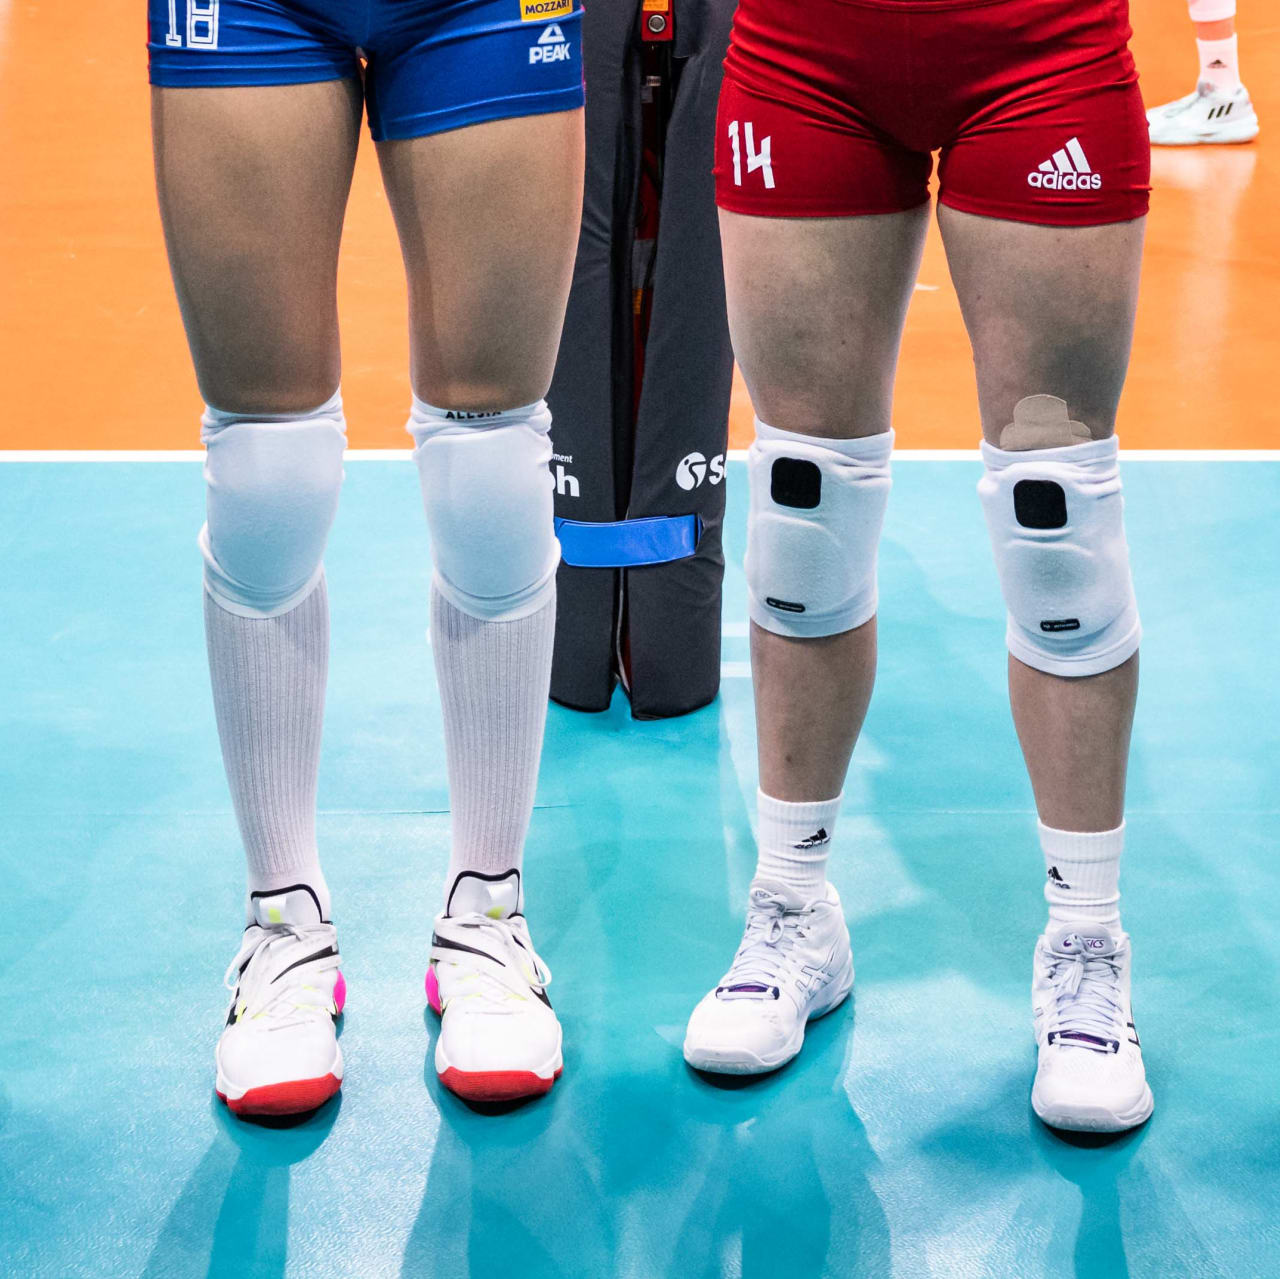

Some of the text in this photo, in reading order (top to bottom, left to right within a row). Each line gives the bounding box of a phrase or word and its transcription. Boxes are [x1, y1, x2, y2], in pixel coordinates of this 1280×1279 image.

[529, 42, 572, 64] PEAK
[728, 120, 776, 189] 14
[1027, 171, 1102, 190] adidas
